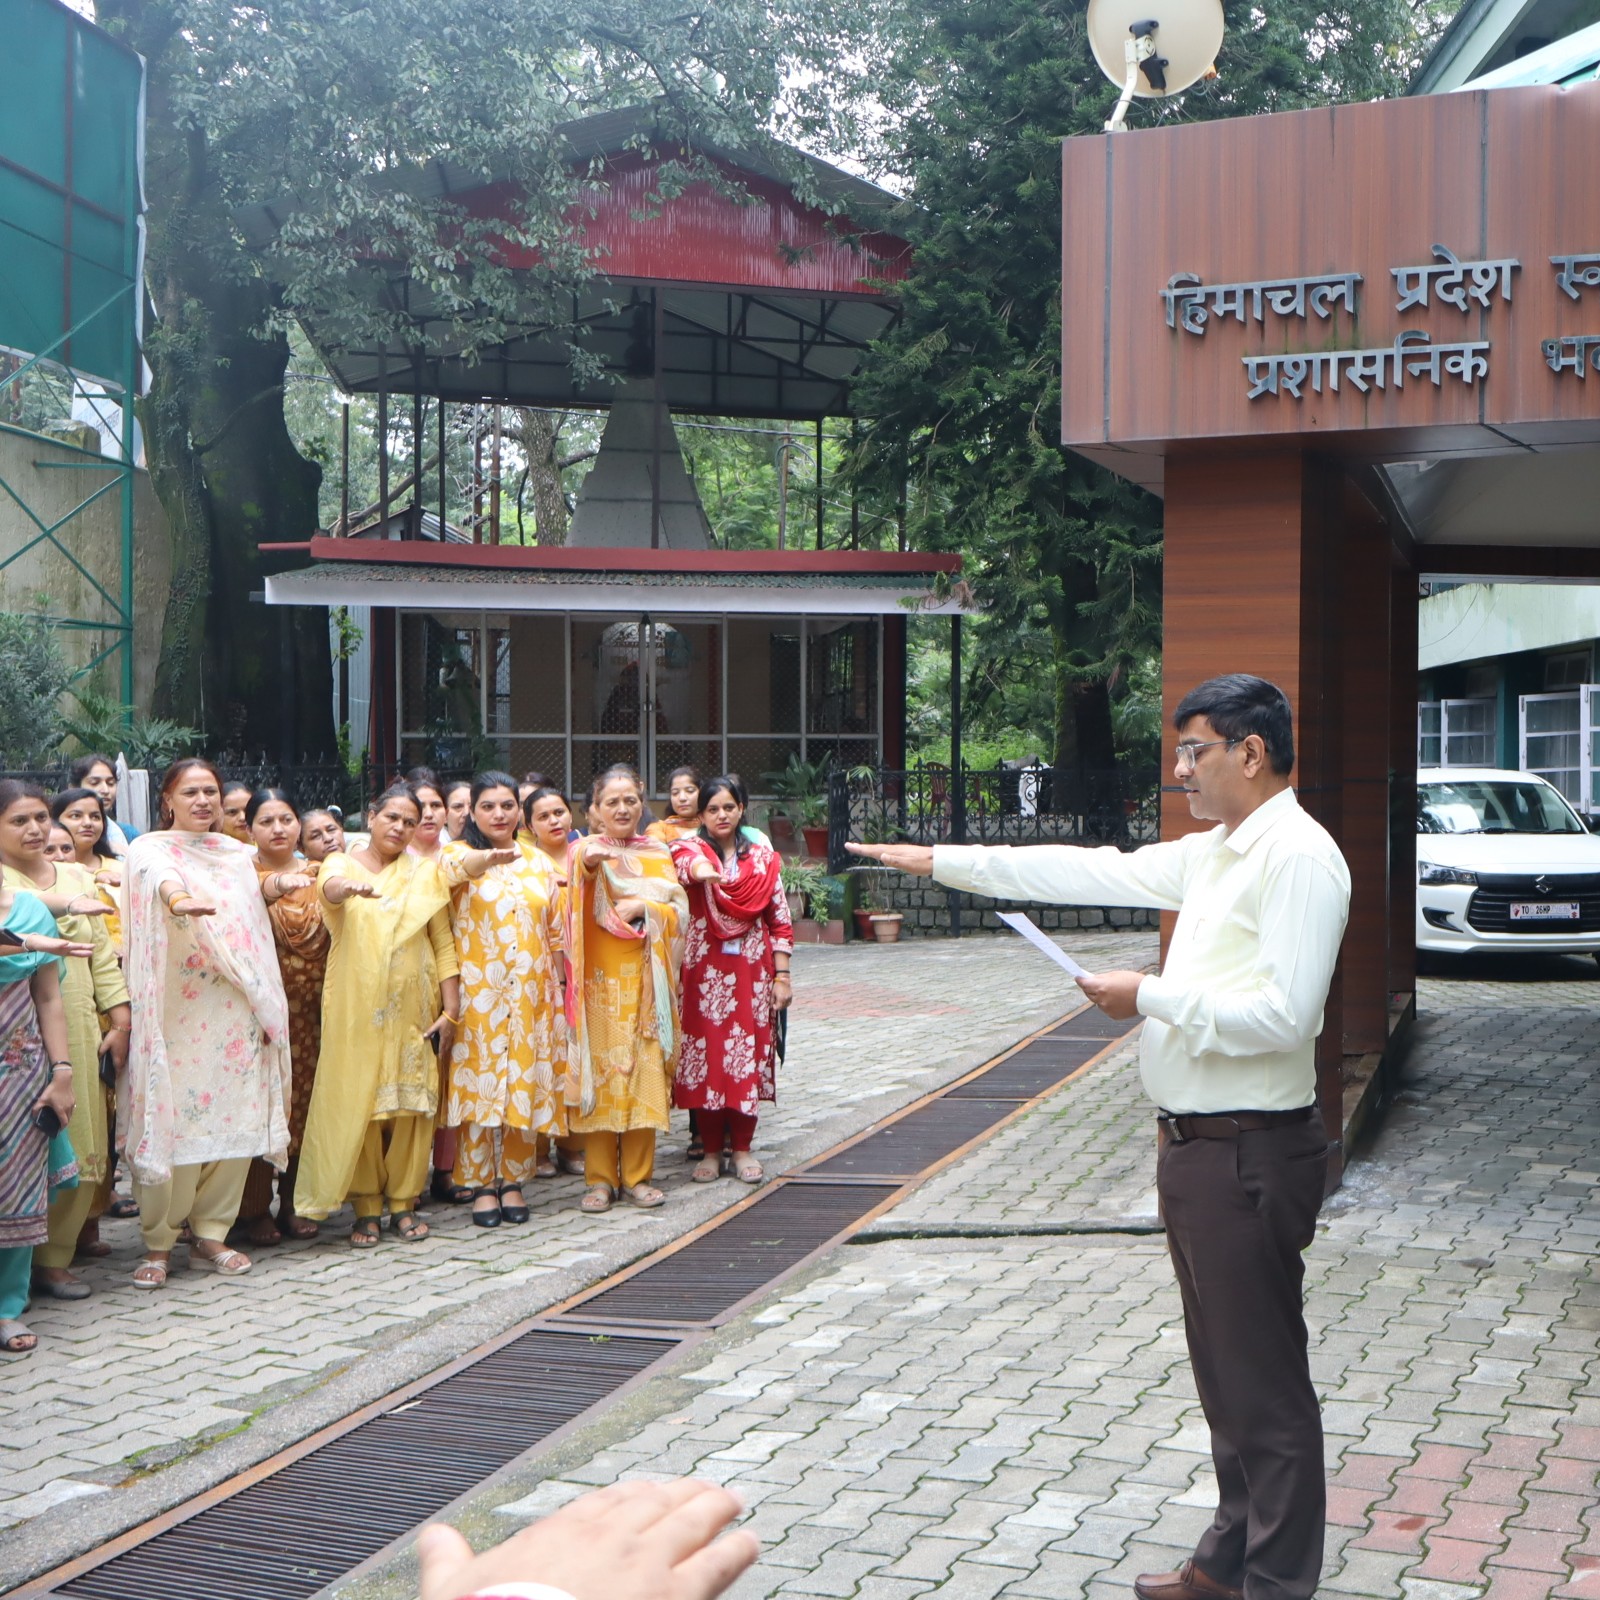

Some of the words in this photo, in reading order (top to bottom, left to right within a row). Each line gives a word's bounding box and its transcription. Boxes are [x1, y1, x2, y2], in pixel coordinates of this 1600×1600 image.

[1158, 272, 1364, 335] हिमाचल
[1389, 243, 1522, 312] प्रदेश
[1241, 329, 1490, 399] प्रशासनिक
